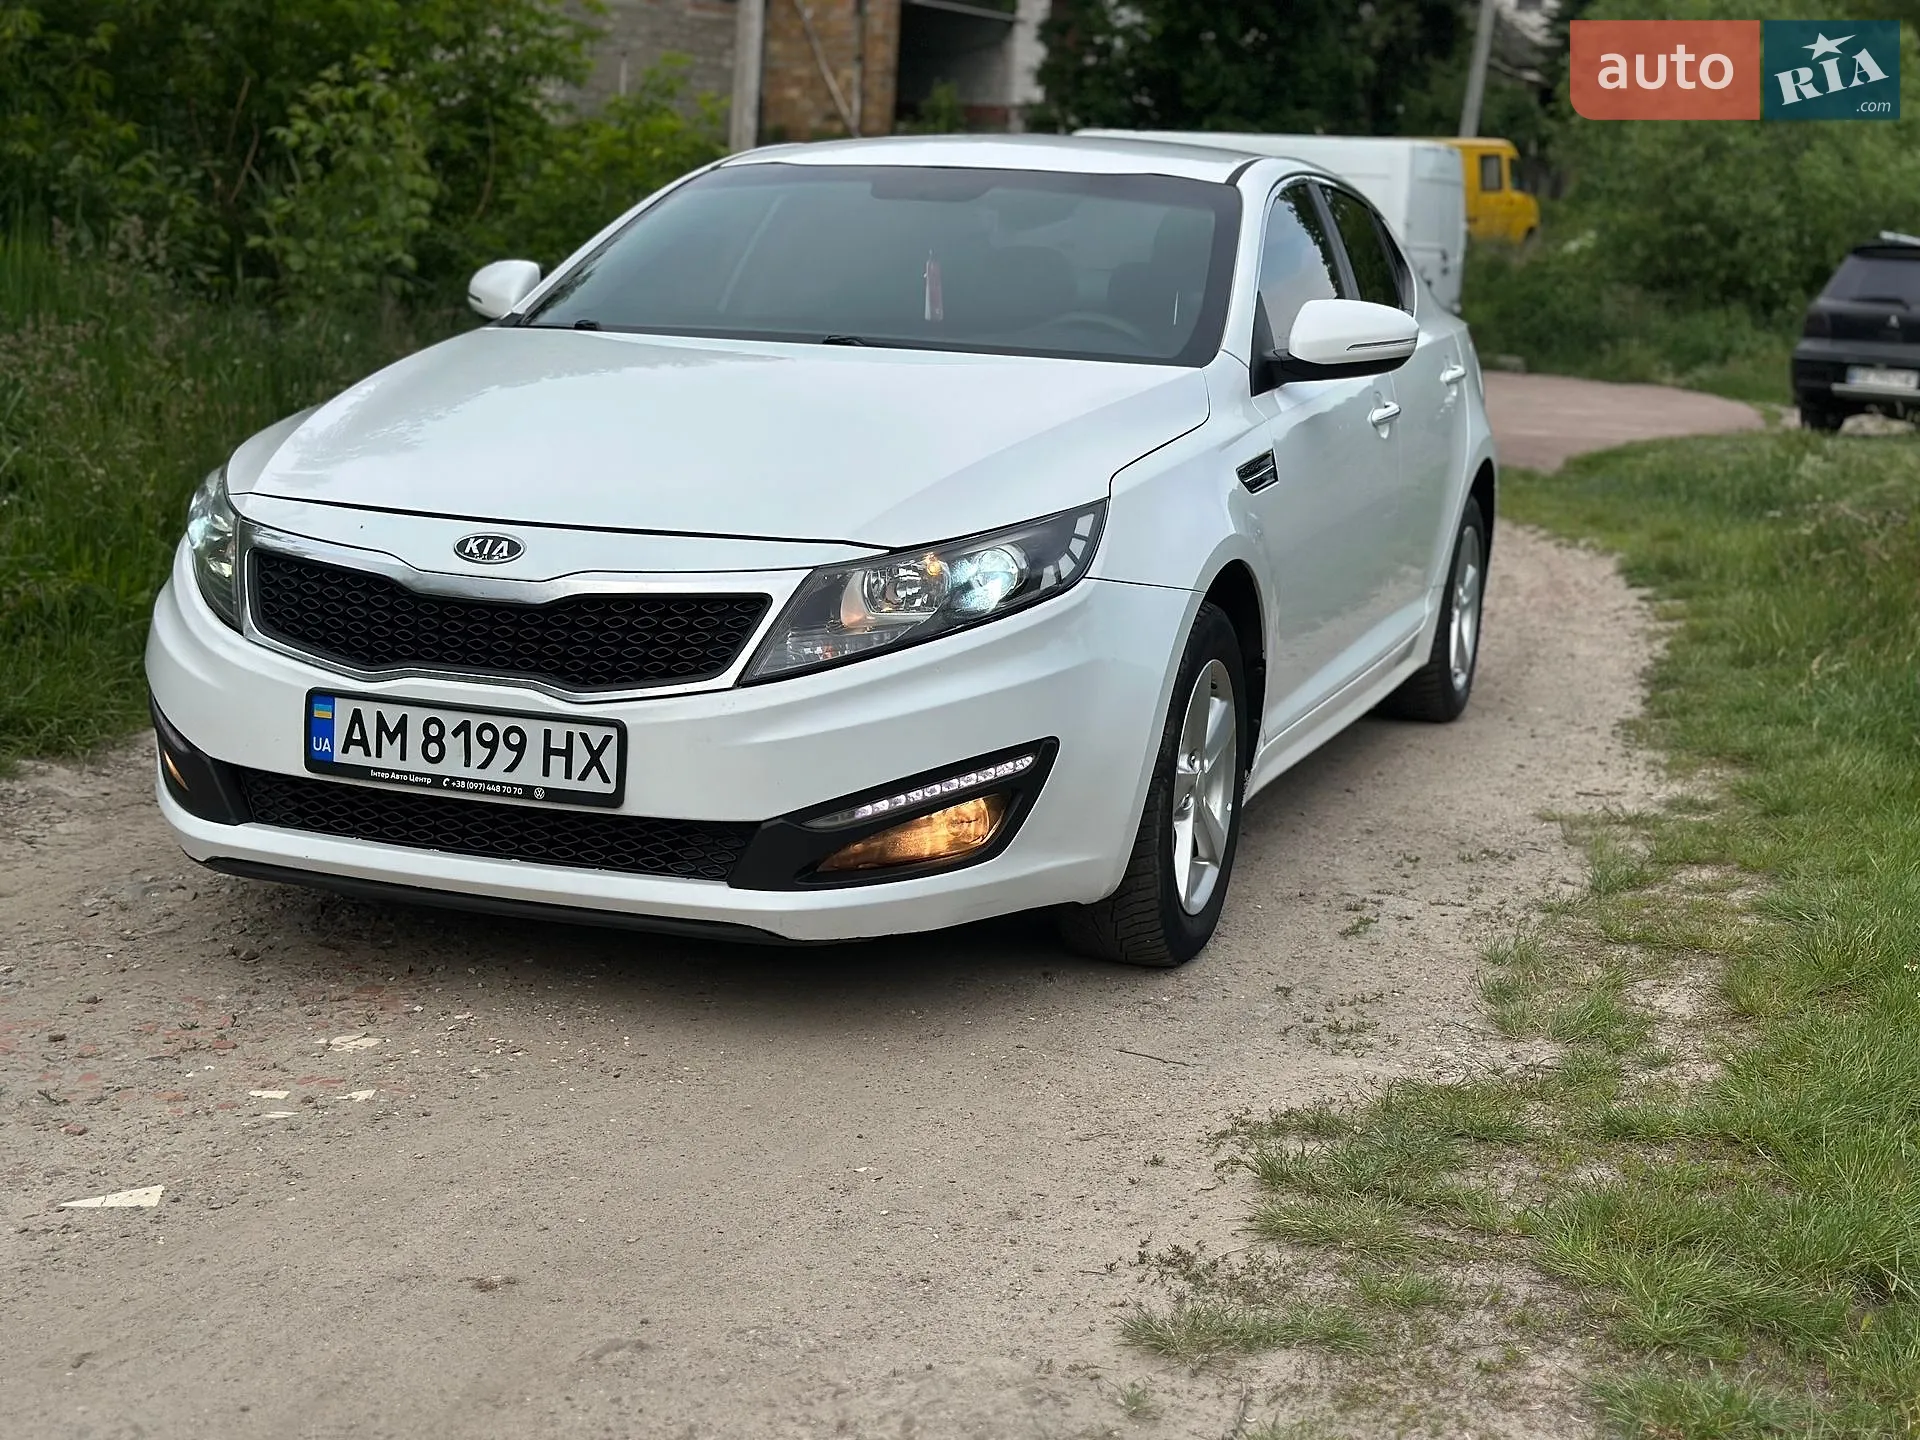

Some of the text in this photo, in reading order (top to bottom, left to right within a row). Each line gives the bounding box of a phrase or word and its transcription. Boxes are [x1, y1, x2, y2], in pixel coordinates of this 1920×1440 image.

[464, 538, 509, 557] KIA
[312, 736, 332, 753] UA
[341, 707, 614, 784] AM 8199 HX
[370, 769, 432, 785] Інтер Авто Центр
[451, 780, 523, 795] +38 (097) 448 70 70
